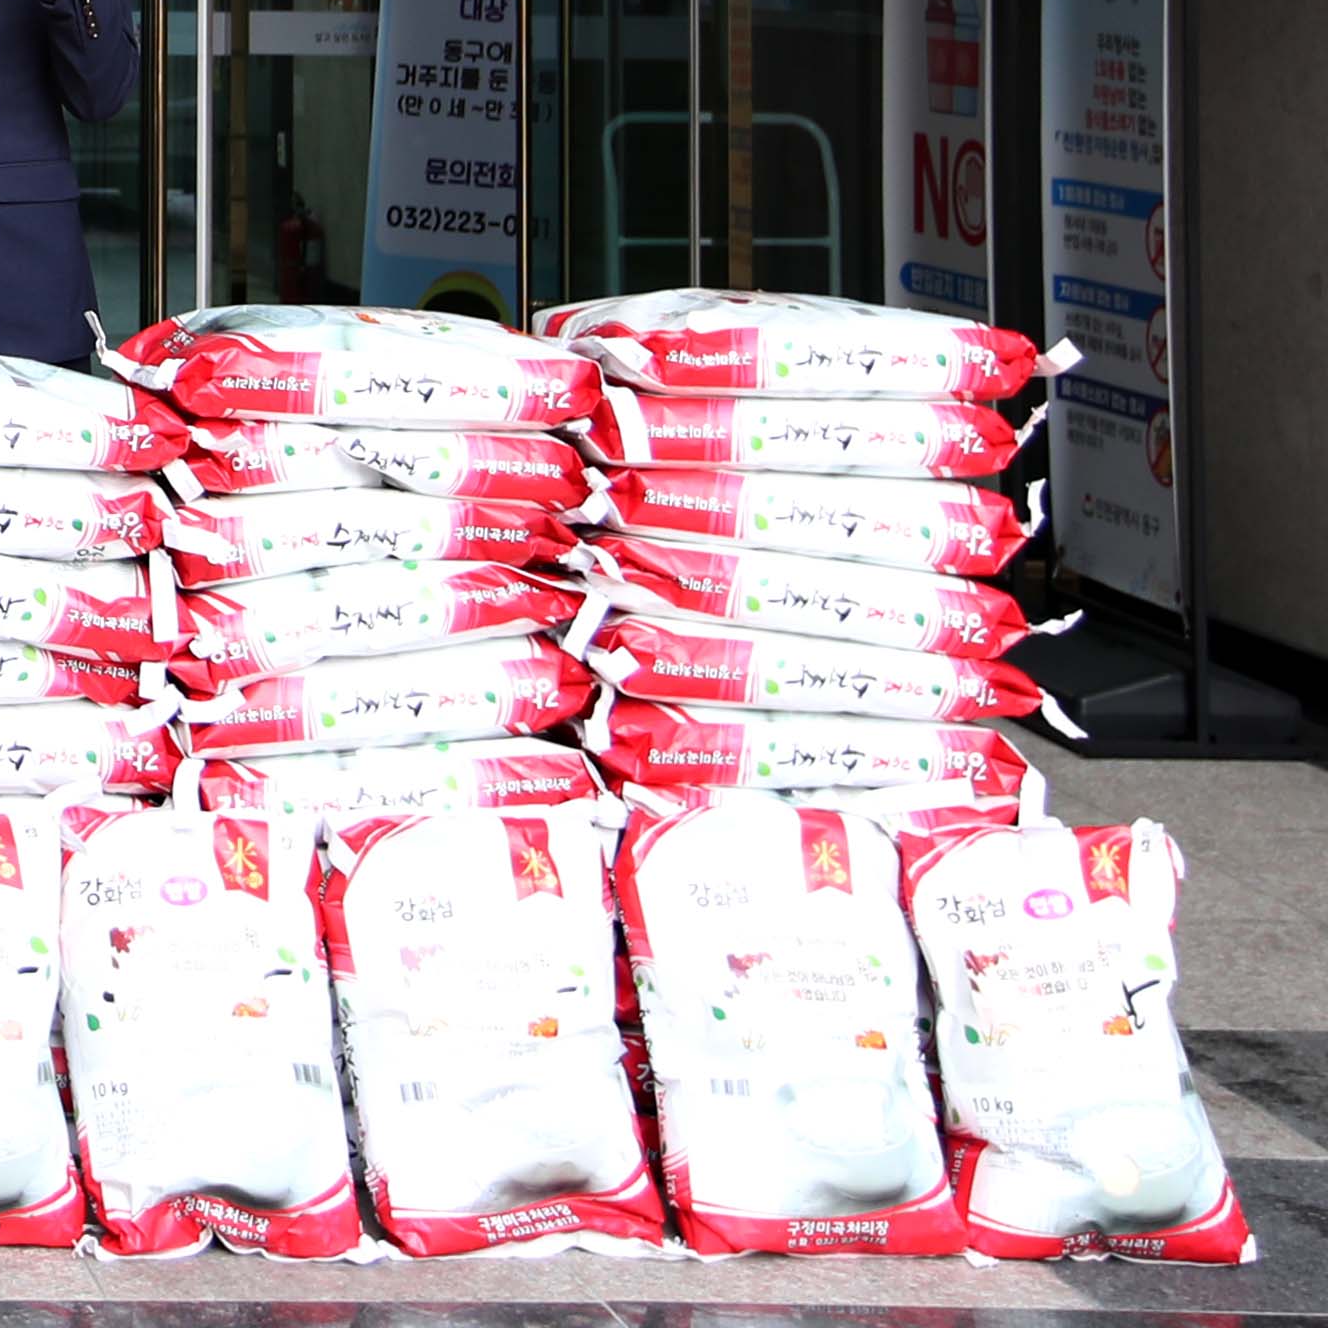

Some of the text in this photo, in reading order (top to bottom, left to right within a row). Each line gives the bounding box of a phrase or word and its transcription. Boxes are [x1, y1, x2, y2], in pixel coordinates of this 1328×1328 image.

[444, 40, 512, 64] 동구에
[426, 158, 516, 188] 문의전화
[226, 837, 258, 871] 米
[80, 875, 143, 907] 강화섬
[936, 895, 1006, 925] 강화섬
[91, 1080, 129, 1099] 10 kg
[972, 1097, 1014, 1115] 10 kg
[787, 1218, 890, 1236] 구정미곡처리장
